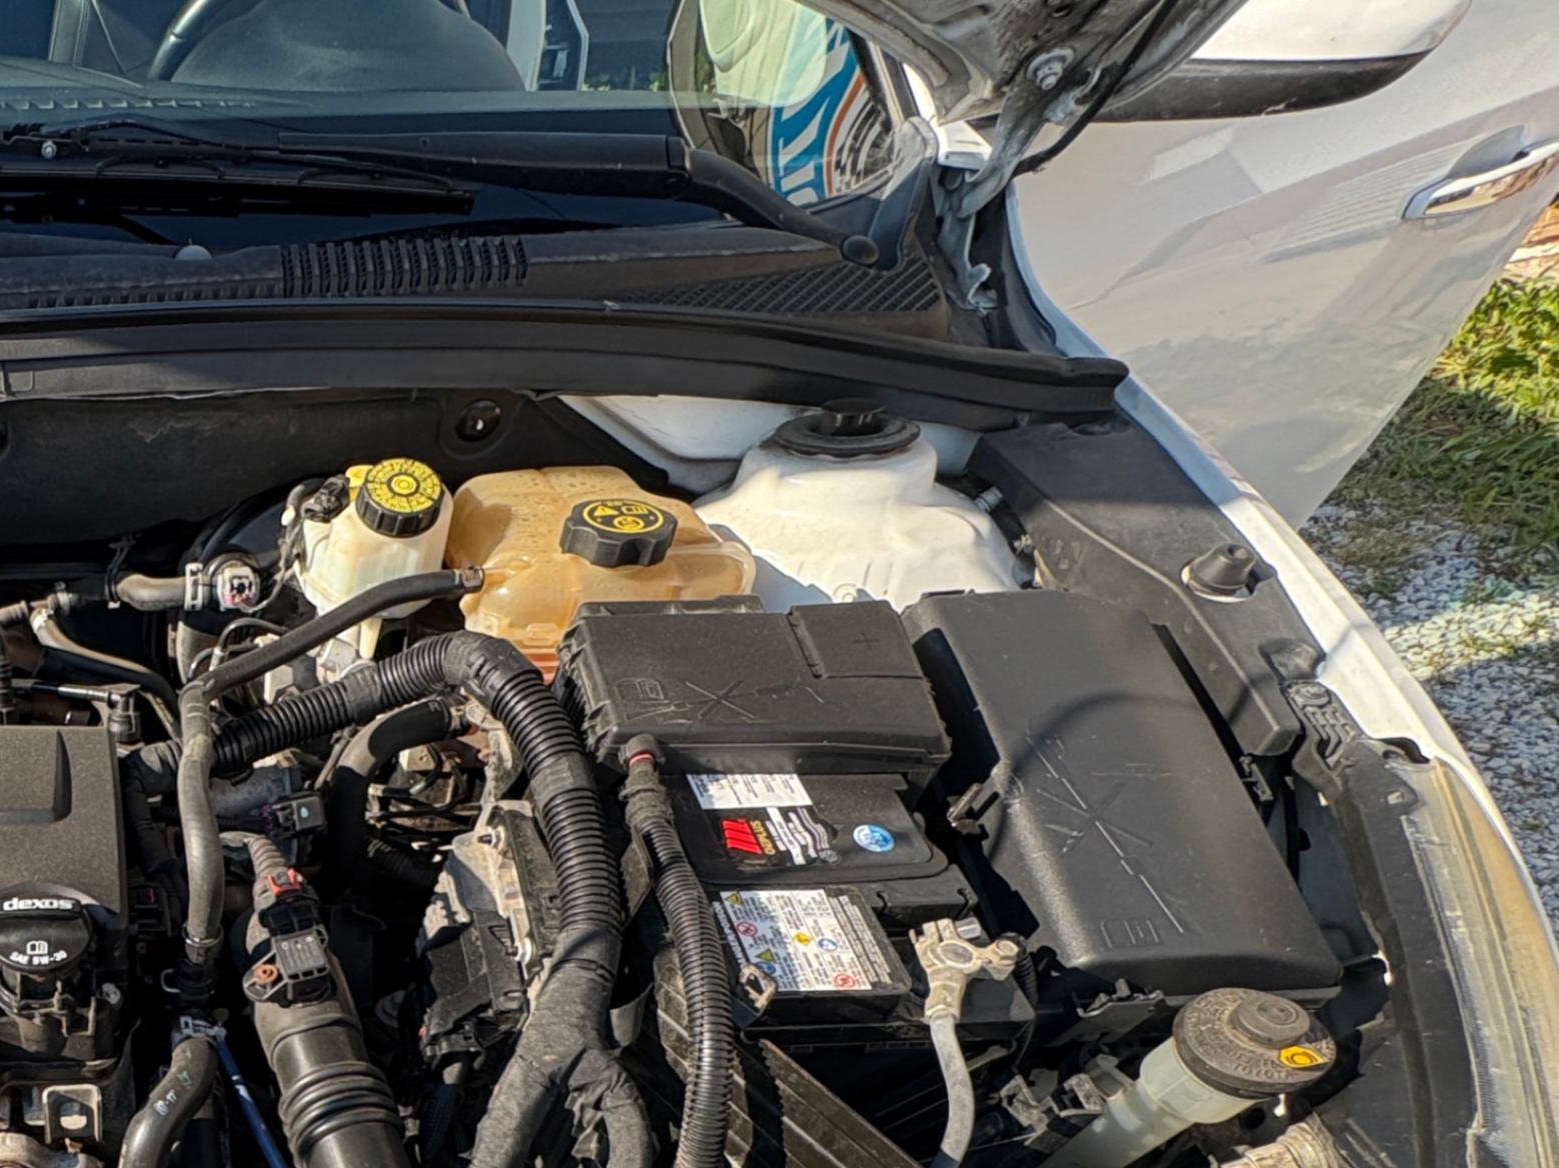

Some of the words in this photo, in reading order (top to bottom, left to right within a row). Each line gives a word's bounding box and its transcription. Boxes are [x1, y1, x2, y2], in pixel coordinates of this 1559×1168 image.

[3, 897, 74, 911] dexos
[9, 951, 29, 965] SAE
[32, 949, 68, 965] 5W-30
[1234, 1063, 1295, 1080] TOYOTA
